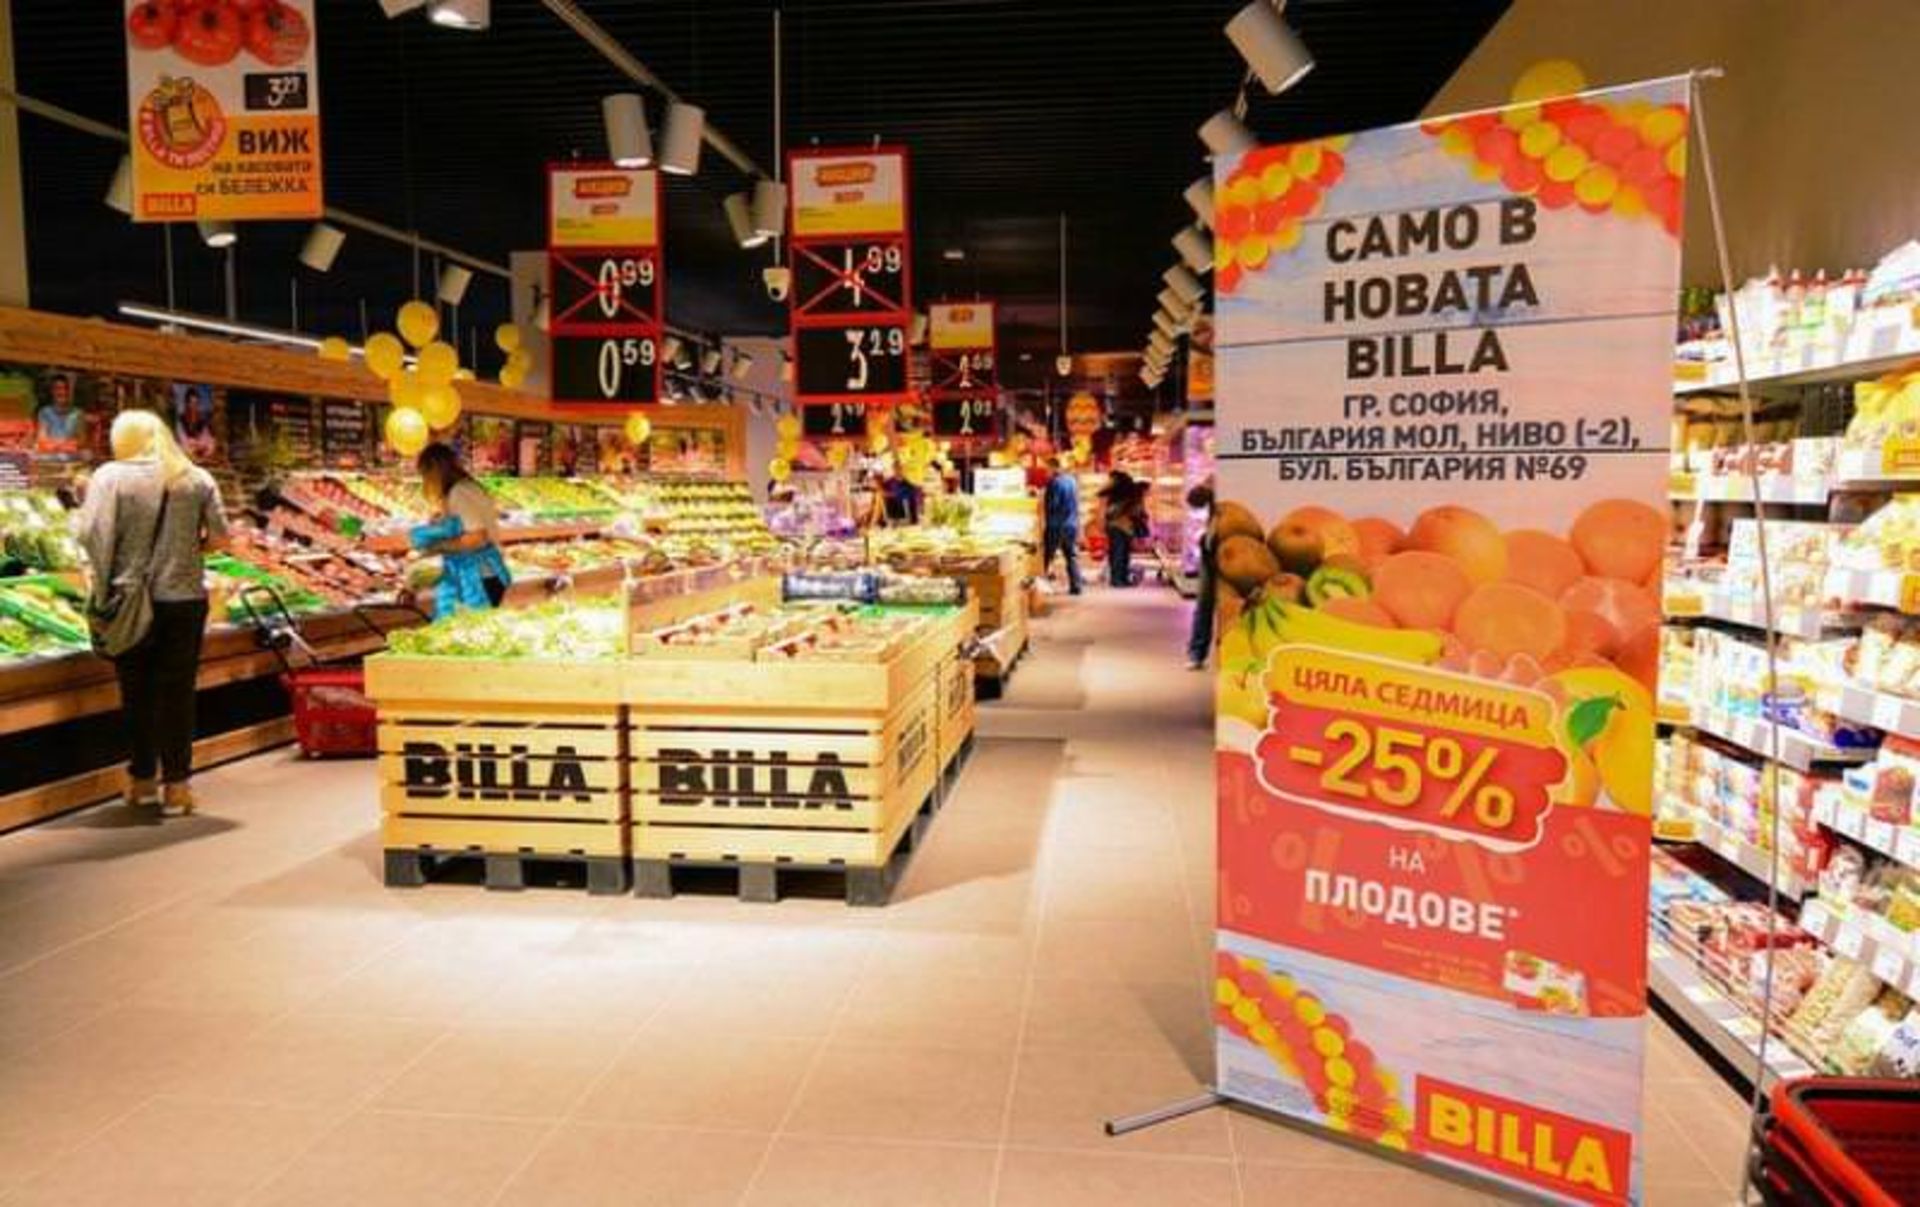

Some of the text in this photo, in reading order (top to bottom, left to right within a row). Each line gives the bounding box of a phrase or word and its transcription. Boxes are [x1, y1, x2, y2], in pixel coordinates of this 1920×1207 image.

[238, 128, 309, 154] ВИЖ
[1326, 198, 1537, 263] САМО В
[1324, 263, 1539, 322] НОВАТА
[1347, 330, 1510, 379] BILLA
[1344, 389, 1509, 418] ГР. СОФИЯ,
[1242, 416, 1640, 451] БЪЛГАРИЯ МОЛ, НИВО (-2),
[1279, 459, 1338, 481] БУЛ.
[1346, 457, 1506, 481] БЪЛГАРИЯ
[1293, 667, 1529, 730] ЦЯЛА СЕДМИЦА
[404, 742, 589, 803] BILLA
[657, 748, 853, 810] BILLA
[1289, 719, 1516, 828] -25%
[1388, 846, 1426, 874] НА
[1428, 1092, 1615, 1193] BILLA
